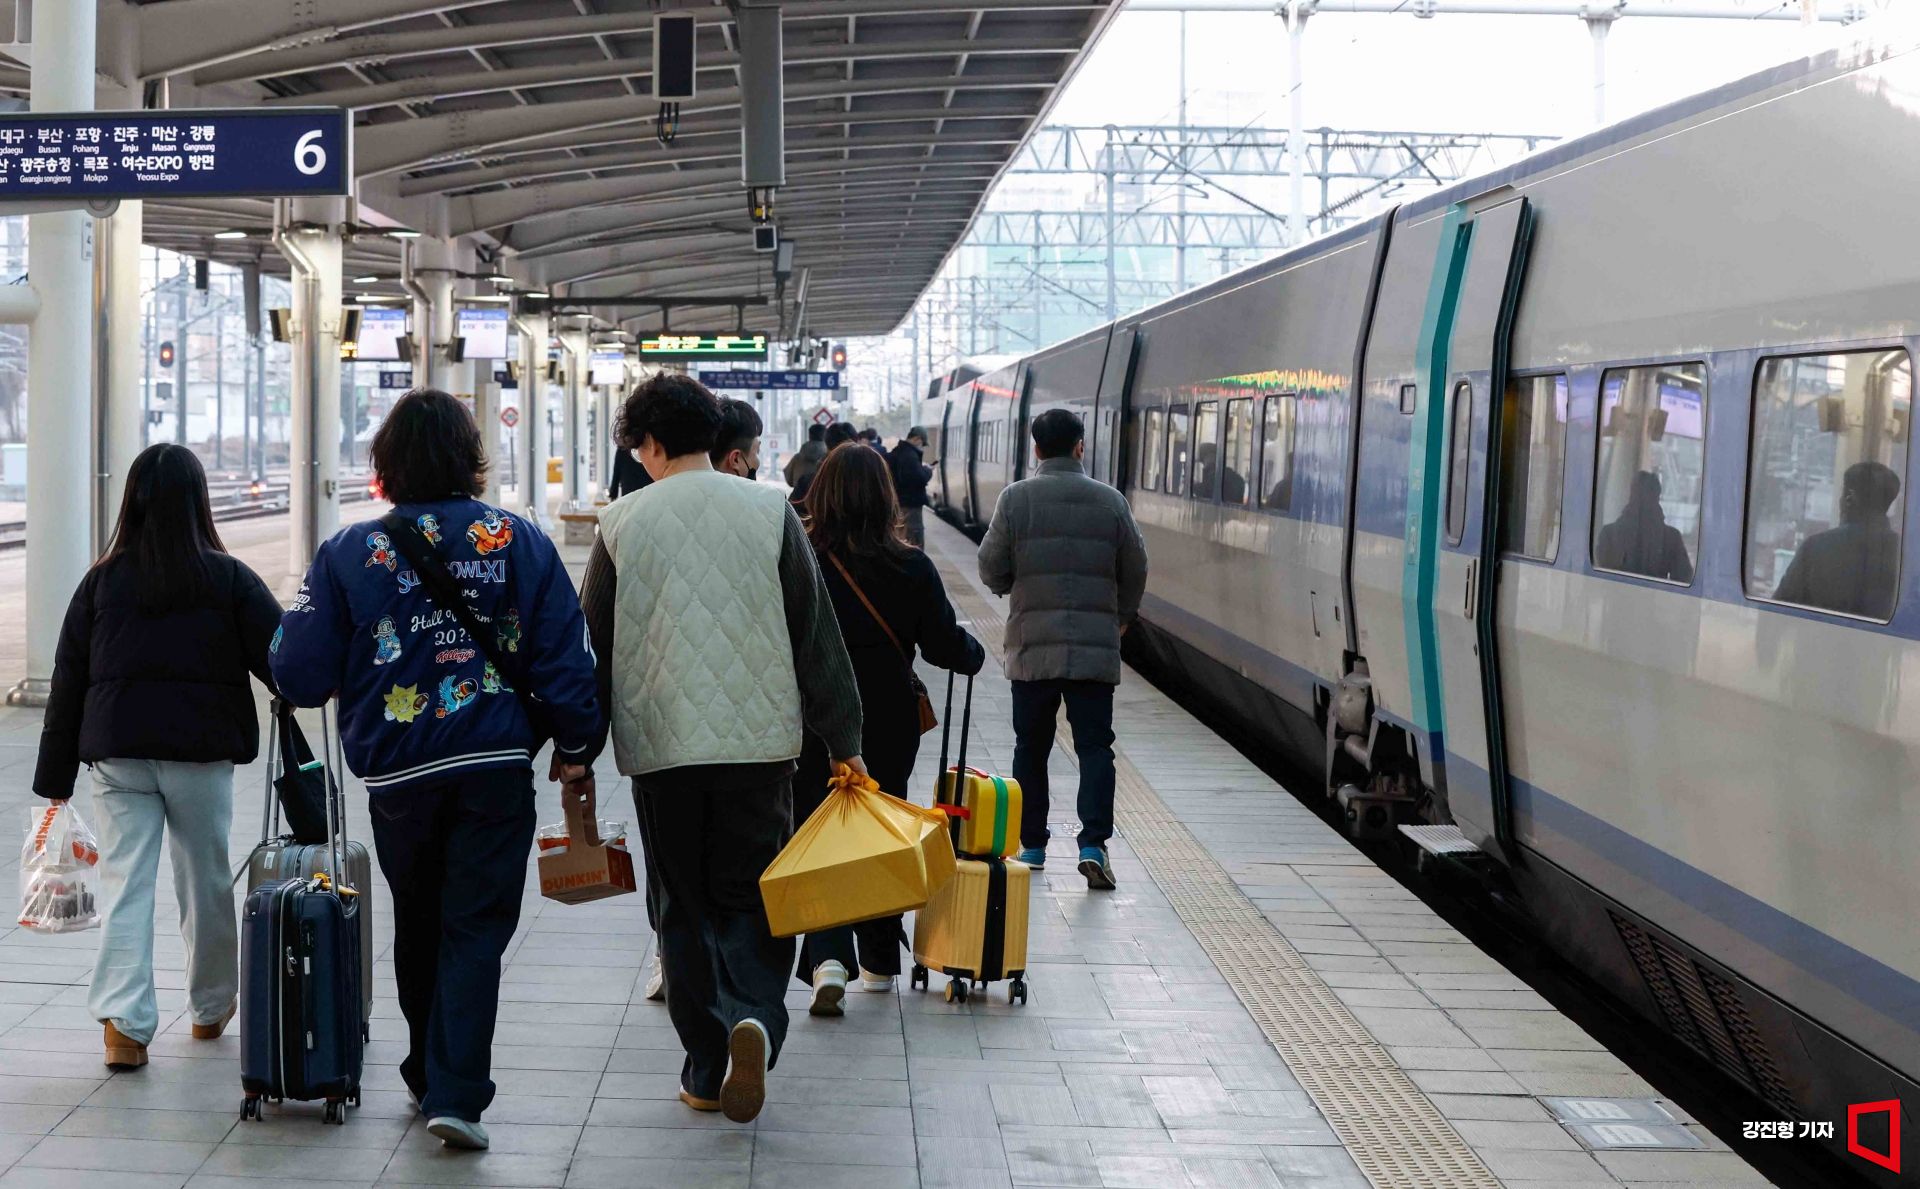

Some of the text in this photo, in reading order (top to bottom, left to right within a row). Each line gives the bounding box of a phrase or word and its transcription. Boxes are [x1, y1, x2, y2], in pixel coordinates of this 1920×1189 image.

[38, 128, 64, 144] 부산
[75, 127, 102, 143] 포항
[113, 126, 139, 142] 진주
[151, 126, 178, 142] 마산
[190, 125, 215, 141] 강릉
[38, 145, 61, 154] Busan
[73, 144, 100, 154] Pohang
[121, 143, 139, 154] Jinju
[152, 143, 177, 152] Masan
[183, 142, 215, 153] Gangneung
[294, 129, 327, 175] 6
[20, 157, 71, 173] 광주송정
[83, 156, 109, 171] 목포
[121, 155, 183, 171] 여수EXPO
[188, 154, 215, 171] 방면
[20, 174, 44, 184] Gwangju
[83, 173, 109, 184] Mokpo
[136, 172, 159, 181] Yeosu
[160, 172, 180, 182] Expo
[410, 610, 444, 633] Hall
